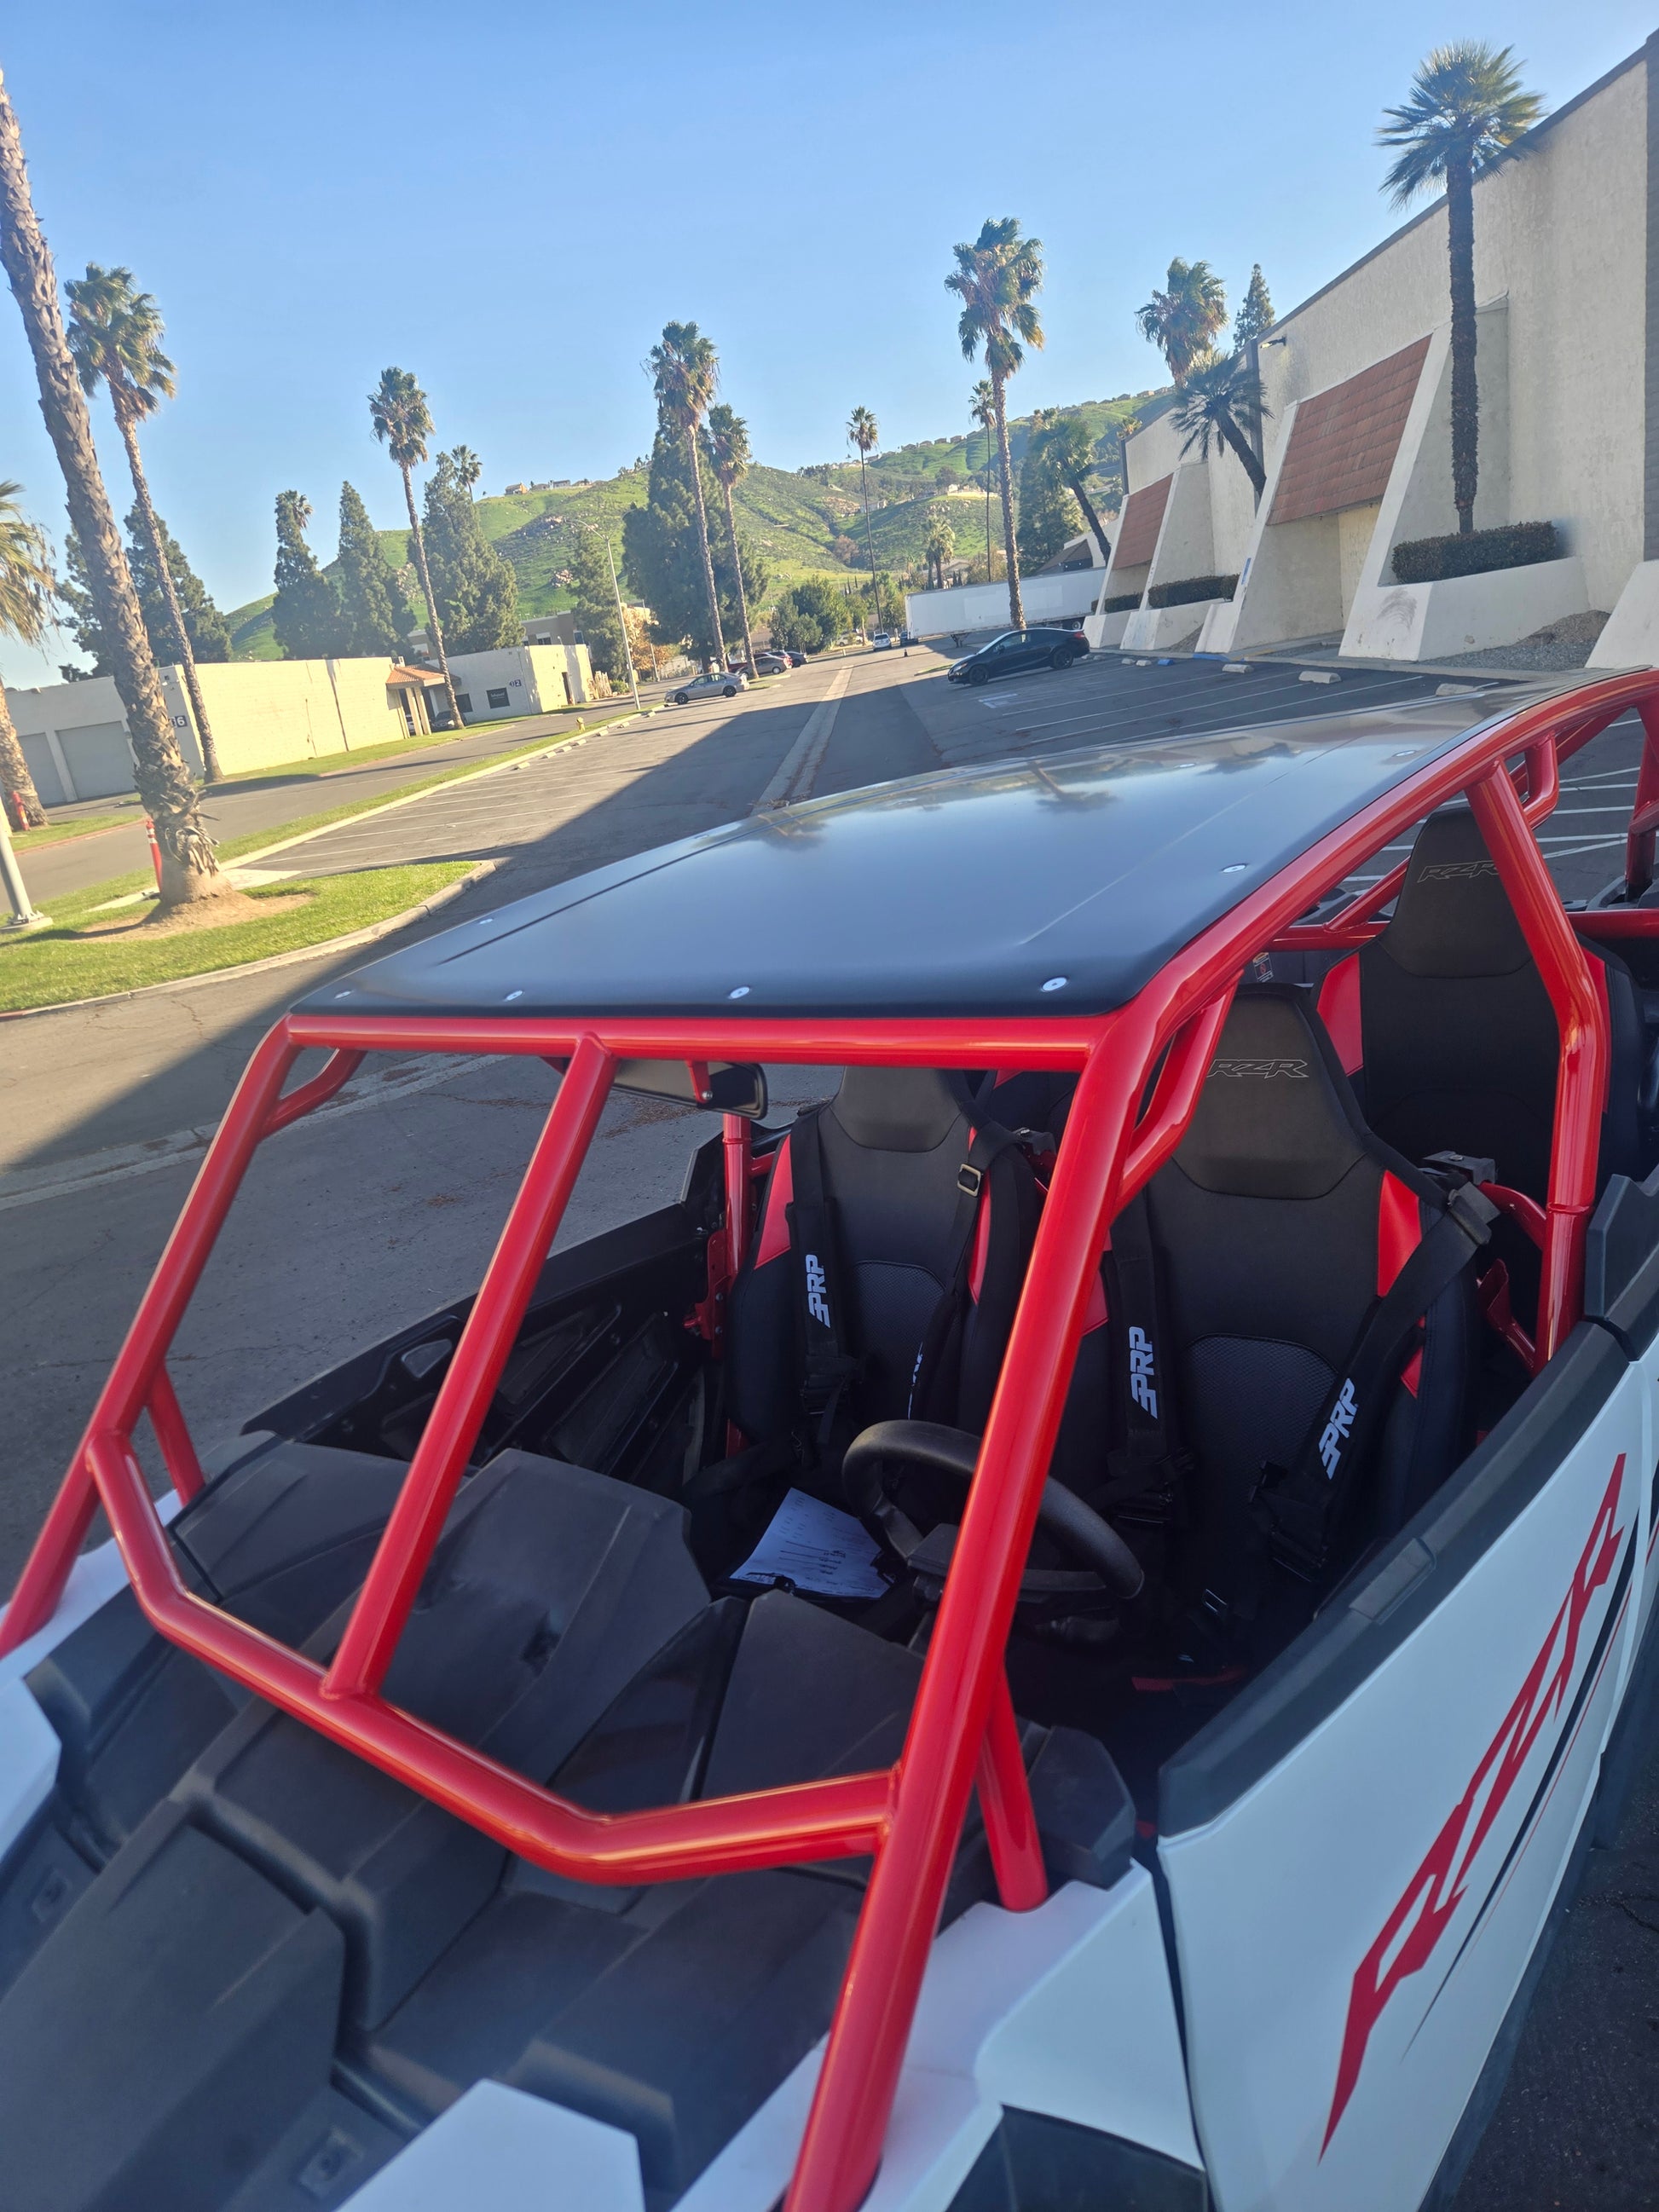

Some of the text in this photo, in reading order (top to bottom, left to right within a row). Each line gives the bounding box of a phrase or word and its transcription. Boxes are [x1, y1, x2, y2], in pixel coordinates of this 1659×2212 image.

[1417, 860, 1499, 883] RZR
[1205, 1059, 1309, 1078] RZR
[805, 1254, 831, 1329] PRP
[1128, 1325, 1158, 1419] PRP
[1318, 1377, 1358, 1480] PRP
